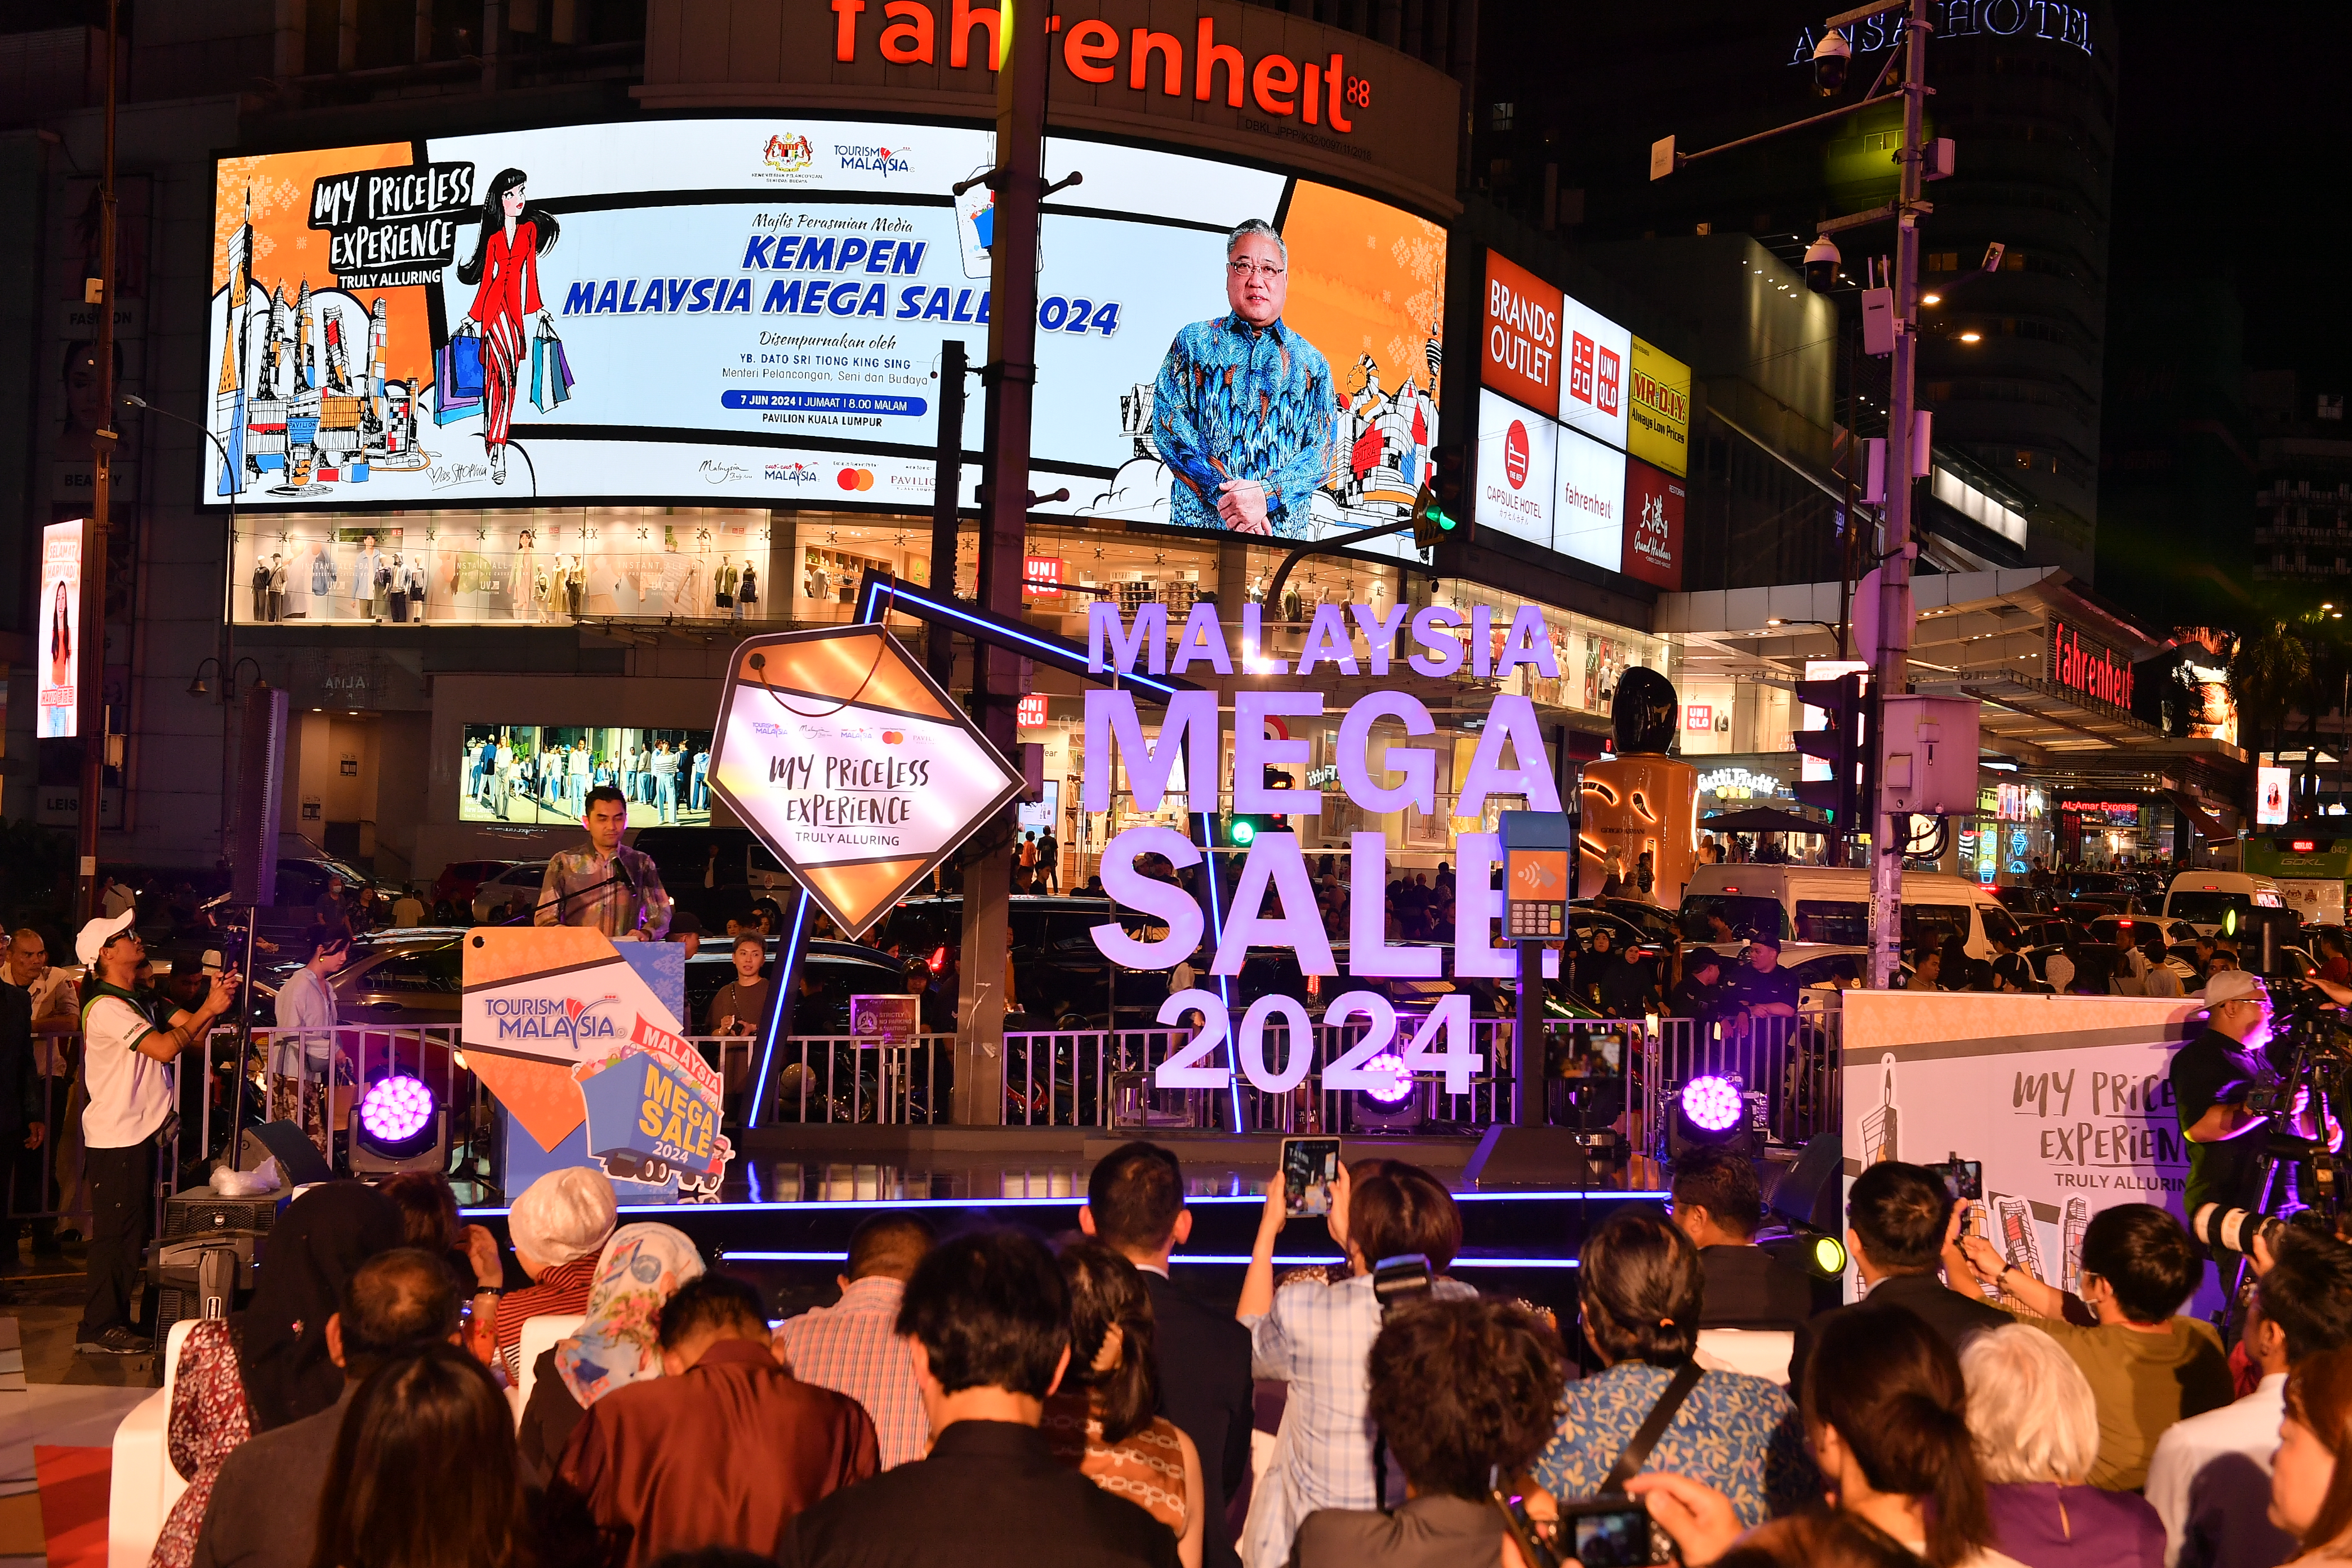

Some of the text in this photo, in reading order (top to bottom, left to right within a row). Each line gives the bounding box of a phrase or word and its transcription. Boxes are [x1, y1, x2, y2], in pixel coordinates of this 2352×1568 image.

[1936, 0, 2092, 56] HOTEL
[832, 0, 1371, 133] fahenheit 88
[834, 145, 880, 157] TOURISM
[841, 157, 908, 178] MALAYSIA
[315, 176, 359, 225] MY
[752, 212, 913, 233] Majlis Perasmian Media
[742, 235, 928, 275] KEMPEN
[340, 270, 441, 288] TRULY ALLURING
[562, 278, 751, 315] MALAYSIA
[762, 280, 885, 317] MEGA
[1037, 296, 1120, 336] 024
[1490, 279, 1555, 348] BRANDS
[70, 312, 132, 325] FASON
[760, 331, 897, 350] Disempurnakan oleh
[740, 353, 911, 369] YB. DATO SRI TIONG KING SING
[1490, 325, 1552, 386] OUTLET
[722, 368, 928, 386] Menteri Pelancongan, Seni dan Budaya
[1600, 354, 1617, 382] UNI
[741, 395, 907, 411] 7 JUN 2024 JUMAAT 8.00 MALAM
[1599, 381, 1617, 408] QLO
[763, 414, 883, 427] PAVILION KUALA LUMPUR
[1631, 407, 1685, 444] Always Low Prices
[65, 474, 122, 487] BEAY
[699, 460, 749, 484] Malaysia
[764, 470, 817, 486] MALAYSIA
[891, 475, 936, 486] PAVILIO
[1565, 482, 1611, 519] fahrenheit
[1668, 484, 1685, 498] RESTORAN
[1487, 485, 1542, 519] CAPSULE HOTEL
[50, 542, 75, 559] SELAMAT
[1634, 530, 1672, 561] Grand Harbour
[47, 565, 62, 580] HARI
[1028, 562, 1056, 577] UNI
[1088, 602, 1561, 678] MALAYSIA
[2056, 622, 2132, 710] fahrenheit
[41, 690, 57, 706] MAVIS
[1018, 699, 1042, 711] UNI
[1018, 712, 1044, 726] QLO
[1689, 707, 1708, 717] UNI
[755, 728, 788, 737] MALAYSIA
[1689, 718, 1709, 728] QLO
[841, 732, 872, 741] MALAYSIA
[1043, 749, 1058, 757] ear
[1083, 689, 1563, 818] MEGA
[769, 754, 814, 790] MY
[1732, 768, 1779, 795] Frutti
[47, 798, 108, 812] LEISE
[2061, 801, 2137, 813] AL-Amar Express
[795, 832, 899, 847] TRULY ALLURING
[485, 999, 564, 1016] TOURISM
[499, 1016, 614, 1050] MALAYSIA
[1155, 988, 1485, 1095] 2024
[642, 1025, 719, 1093] MALAYSIA
[644, 1063, 713, 1133] MEGA
[2012, 1068, 2075, 1117] MY
[639, 1099, 713, 1159] SALE
[652, 1141, 689, 1164] 2024
[2054, 1173, 2186, 1192] TRULY ALLURIN
